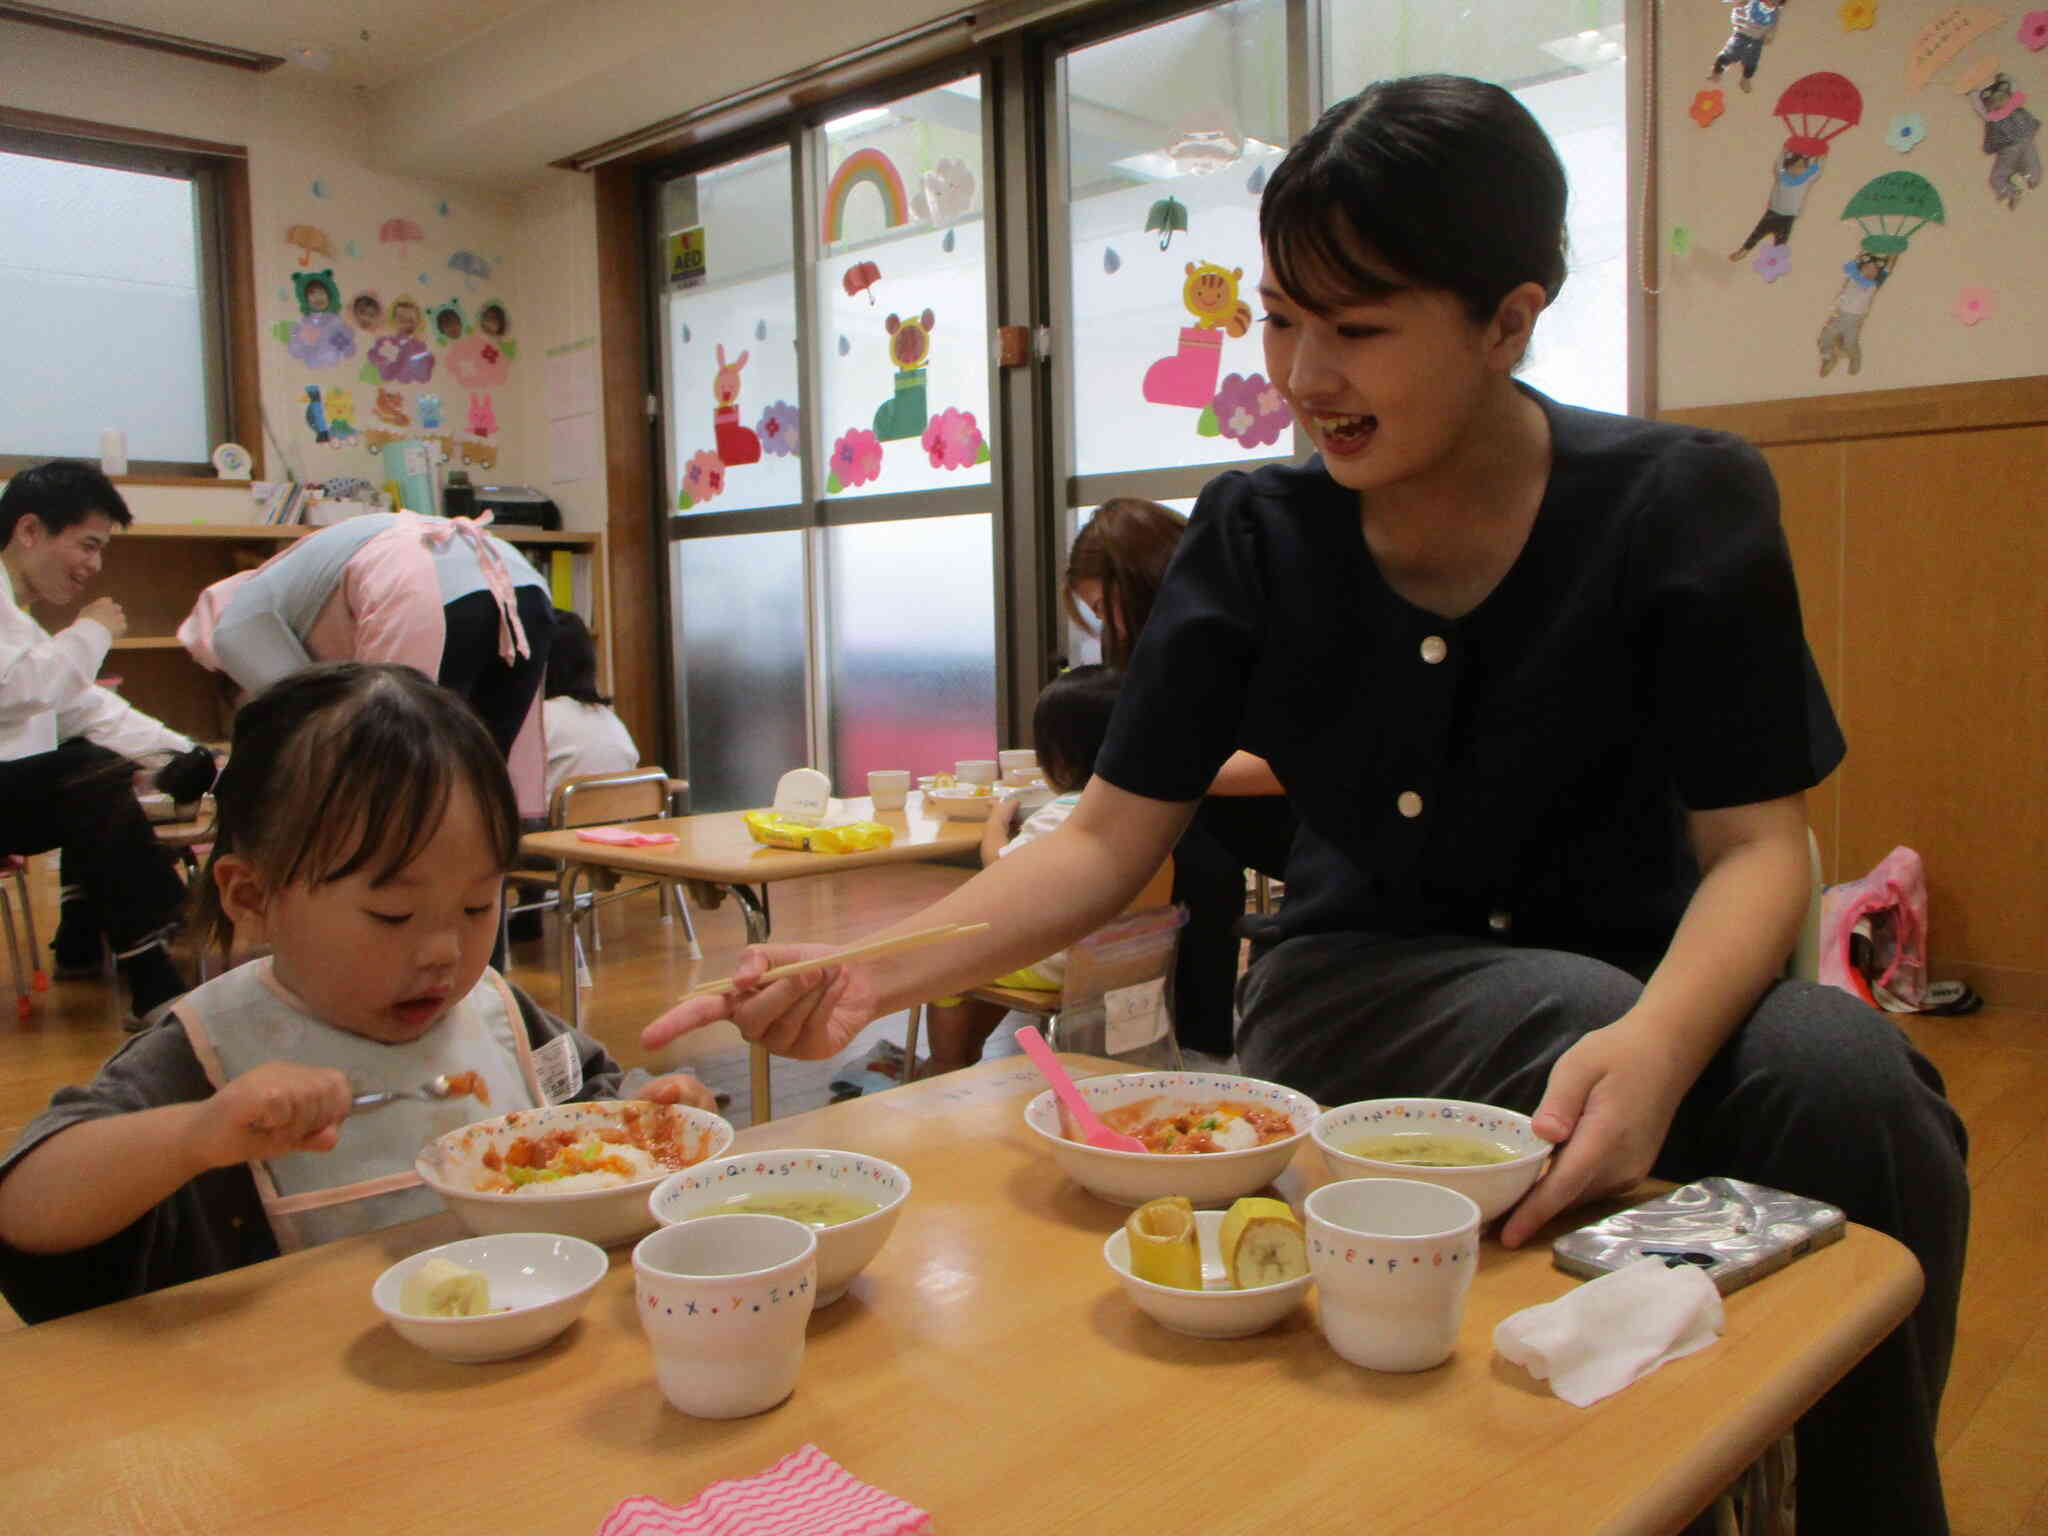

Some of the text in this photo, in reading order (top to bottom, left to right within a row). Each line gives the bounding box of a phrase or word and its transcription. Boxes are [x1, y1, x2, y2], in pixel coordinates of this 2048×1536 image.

[674, 249, 703, 269] AED
[726, 1164, 740, 1176] Q
[780, 1163, 790, 1176] S
[1388, 1259, 1398, 1273] F
[685, 1301, 698, 1316] X
[730, 1296, 743, 1310] Y
